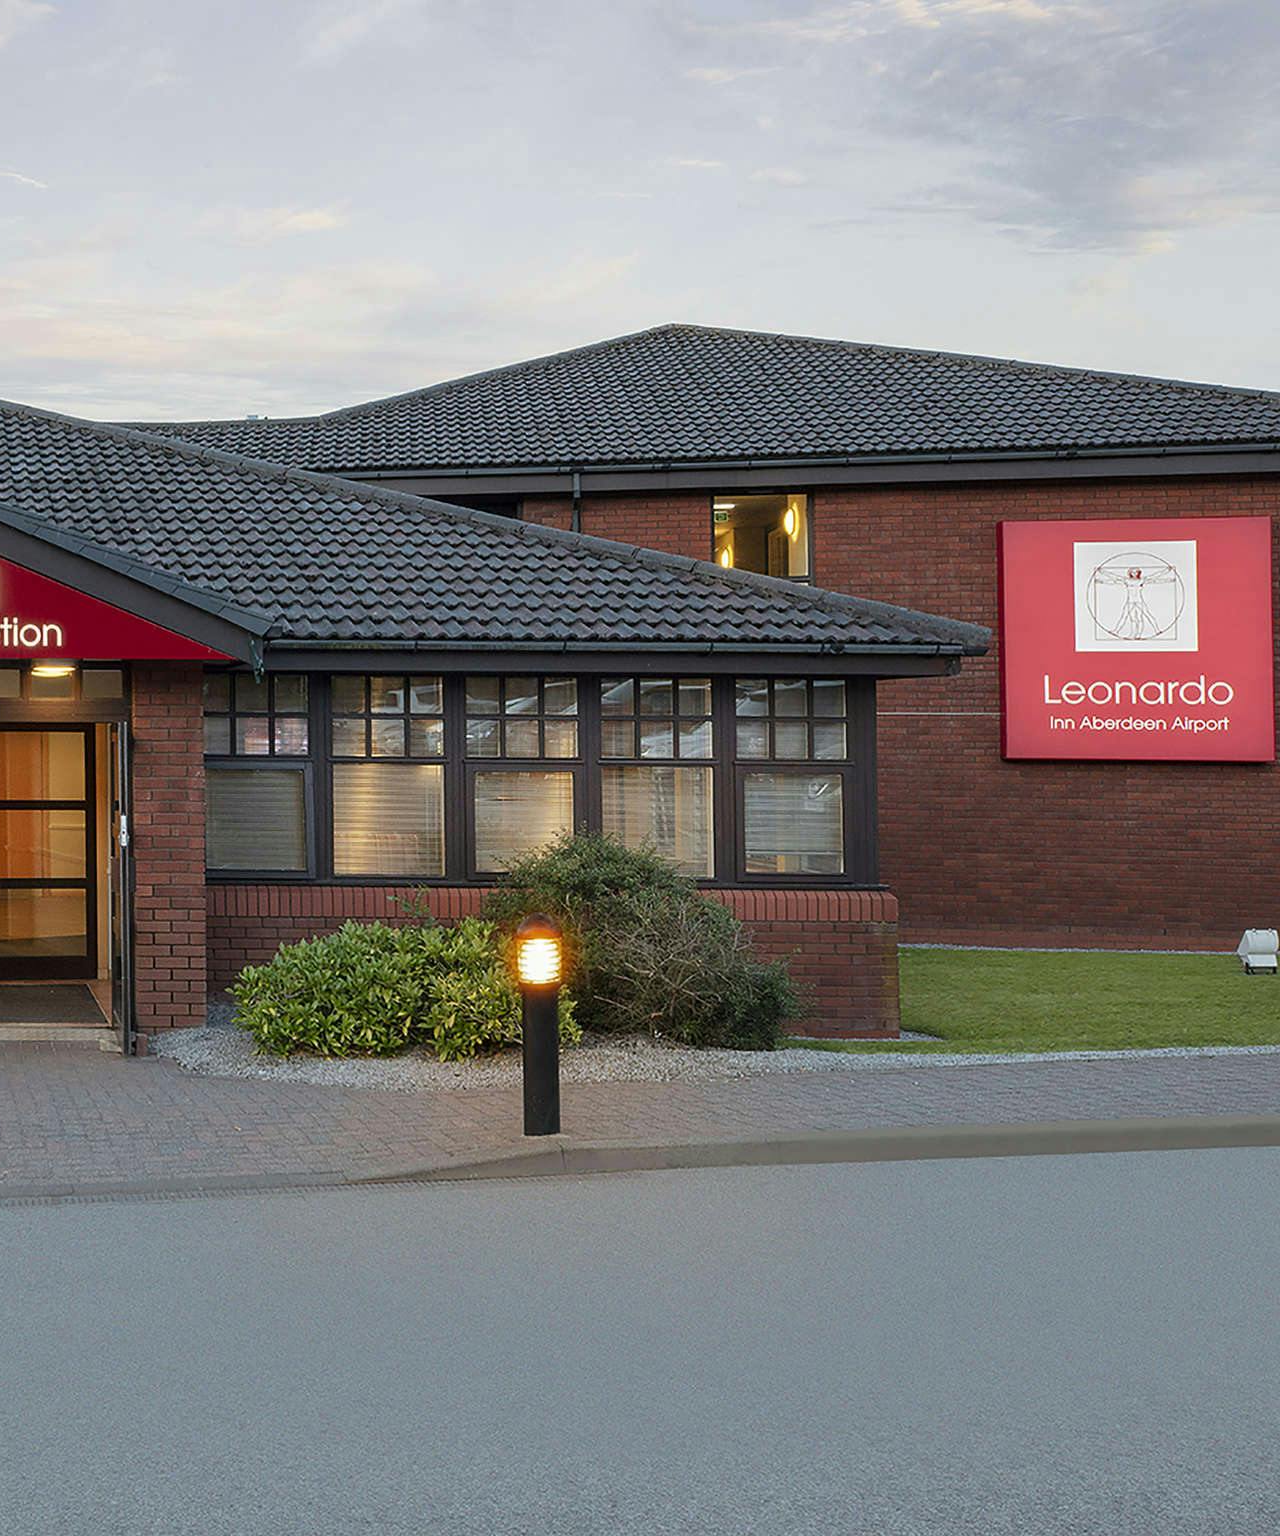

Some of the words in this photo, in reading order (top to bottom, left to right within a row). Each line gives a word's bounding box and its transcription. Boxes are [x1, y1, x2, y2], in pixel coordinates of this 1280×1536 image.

[1043, 674, 1234, 705] Leonardo
[1050, 715, 1075, 730] Inn
[1079, 716, 1167, 731] Aberdeen
[1171, 716, 1230, 733] Airport
